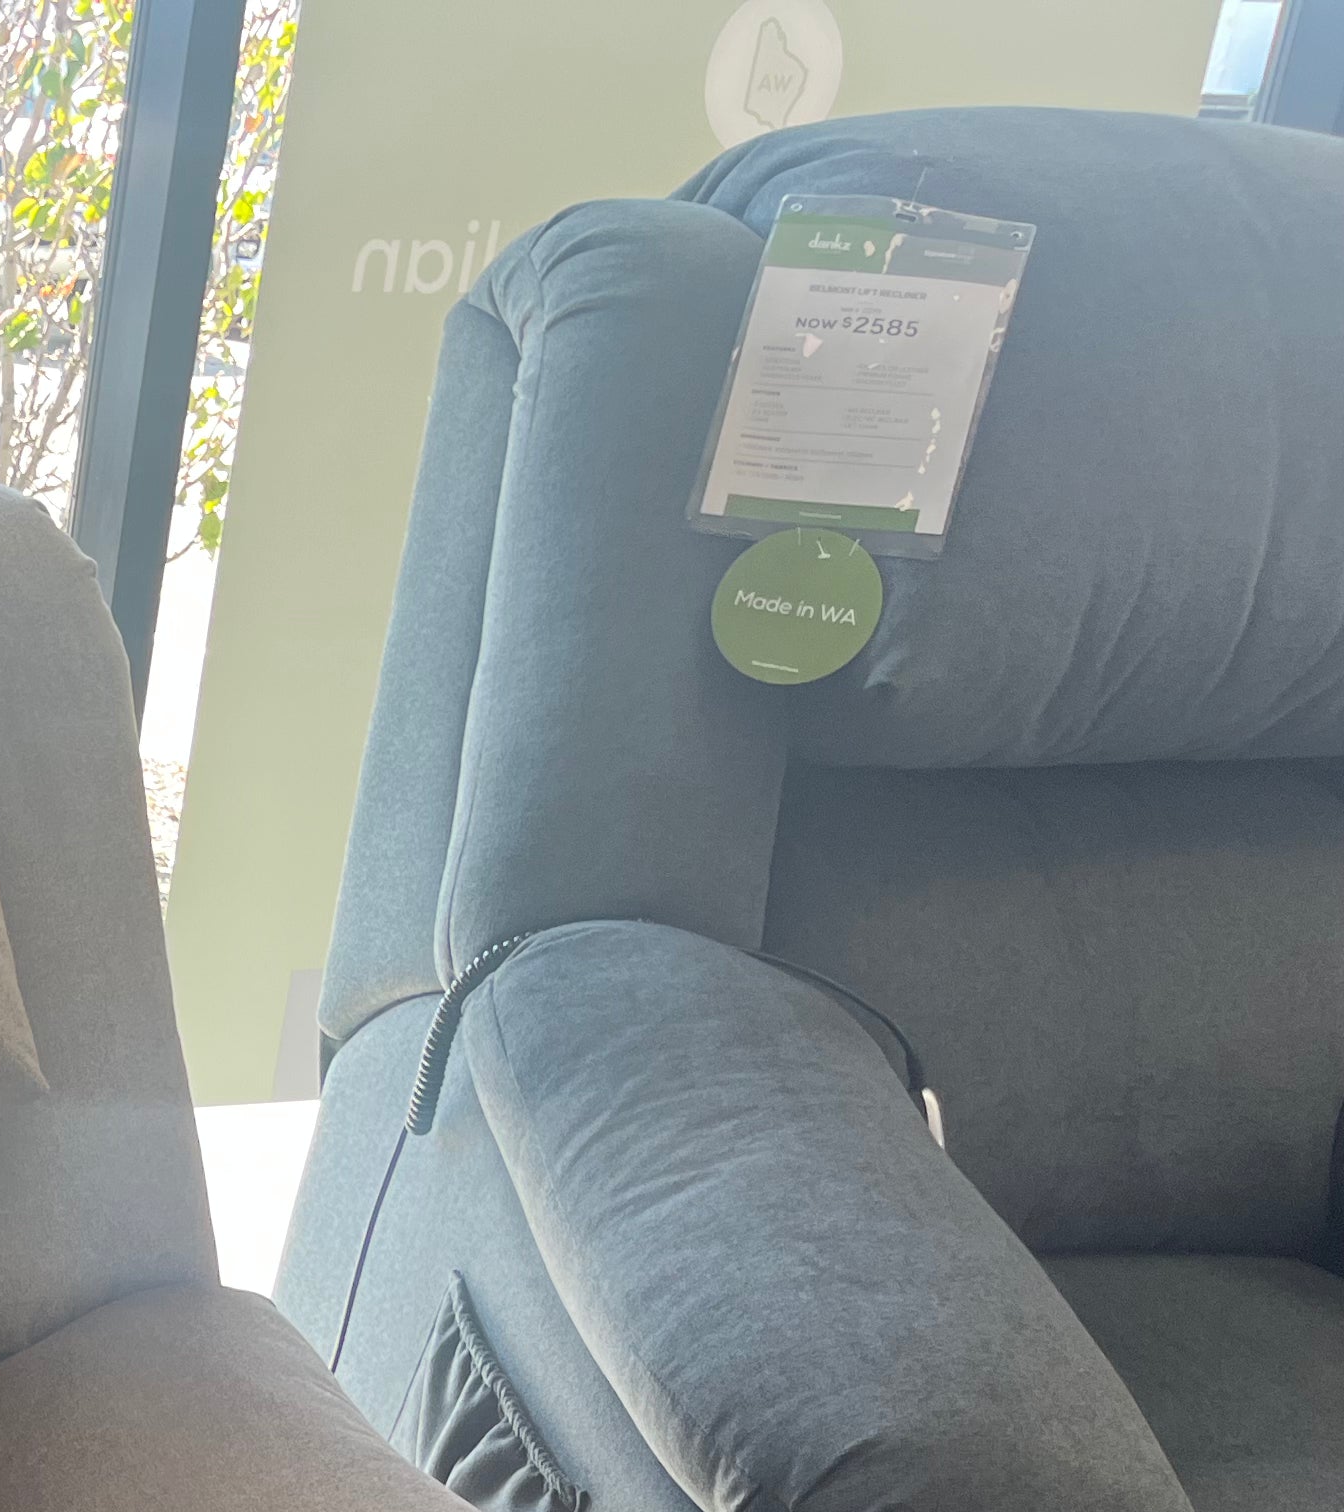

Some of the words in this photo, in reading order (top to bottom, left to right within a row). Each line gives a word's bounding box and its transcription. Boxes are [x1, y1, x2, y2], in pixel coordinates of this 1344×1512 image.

[808, 232, 851, 252] dankz
[809, 284, 856, 295] BELMONT
[858, 288, 878, 297] LIFT
[879, 289, 928, 300] RECLINER
[795, 317, 838, 330] NOW
[842, 316, 919, 337] $2585
[733, 589, 793, 615] Made
[796, 600, 814, 619] in
[820, 603, 856, 626] WA
